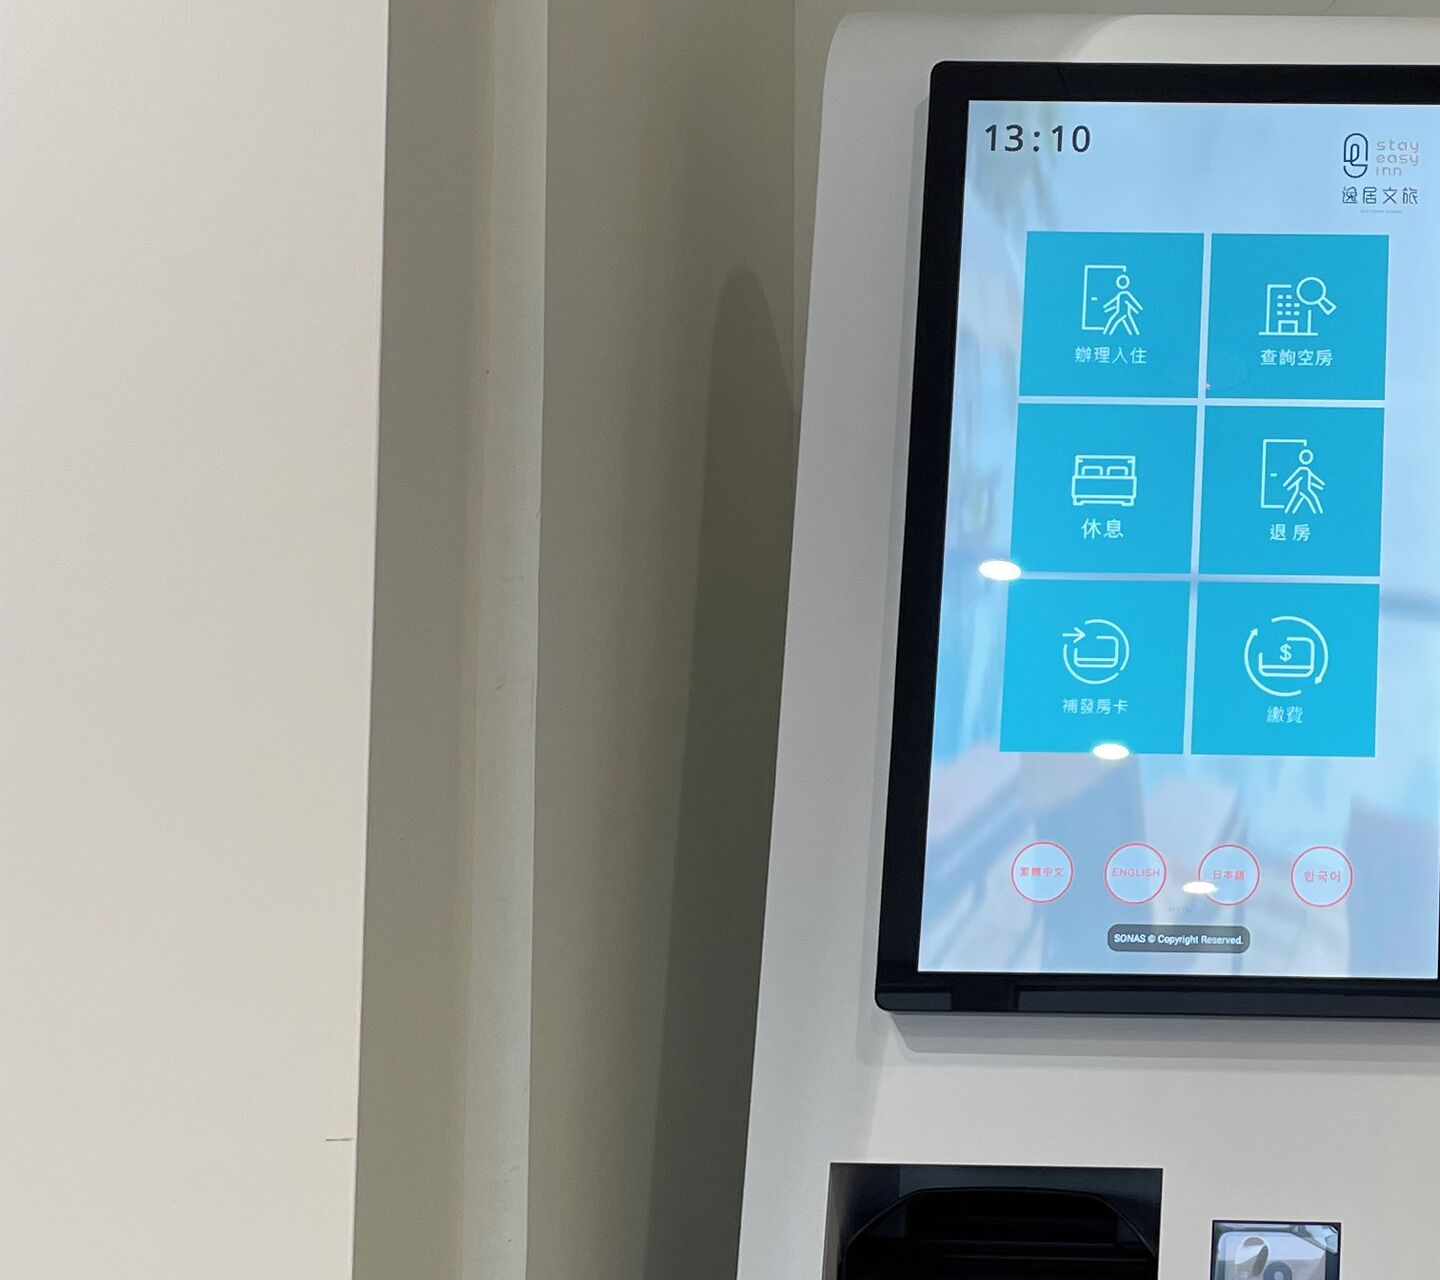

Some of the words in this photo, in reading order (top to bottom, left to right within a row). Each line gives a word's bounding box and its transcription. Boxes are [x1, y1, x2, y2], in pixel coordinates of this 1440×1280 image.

[984, 124, 1091, 153] 13:10
[1376, 139, 1420, 153] stay
[1376, 154, 1420, 167] easy
[1376, 166, 1403, 177] inn
[1342, 186, 1419, 205] 逸居文旅
[1074, 346, 1148, 365] 辦理入住
[1260, 348, 1333, 367] 查詢空房
[1081, 518, 1124, 539] 休息
[1269, 523, 1311, 542] 退房
[1062, 697, 1129, 715] 補發房卡
[1266, 705, 1304, 724] 繳費
[1019, 866, 1065, 878] 繁體中文
[1111, 867, 1161, 878] ENGLISH
[1212, 870, 1246, 882] 日本語
[1303, 870, 1342, 883] 한국어
[1113, 933, 1147, 944] SONAS
[1157, 934, 1199, 947] Copyright
[1201, 935, 1244, 946] Reserved.
